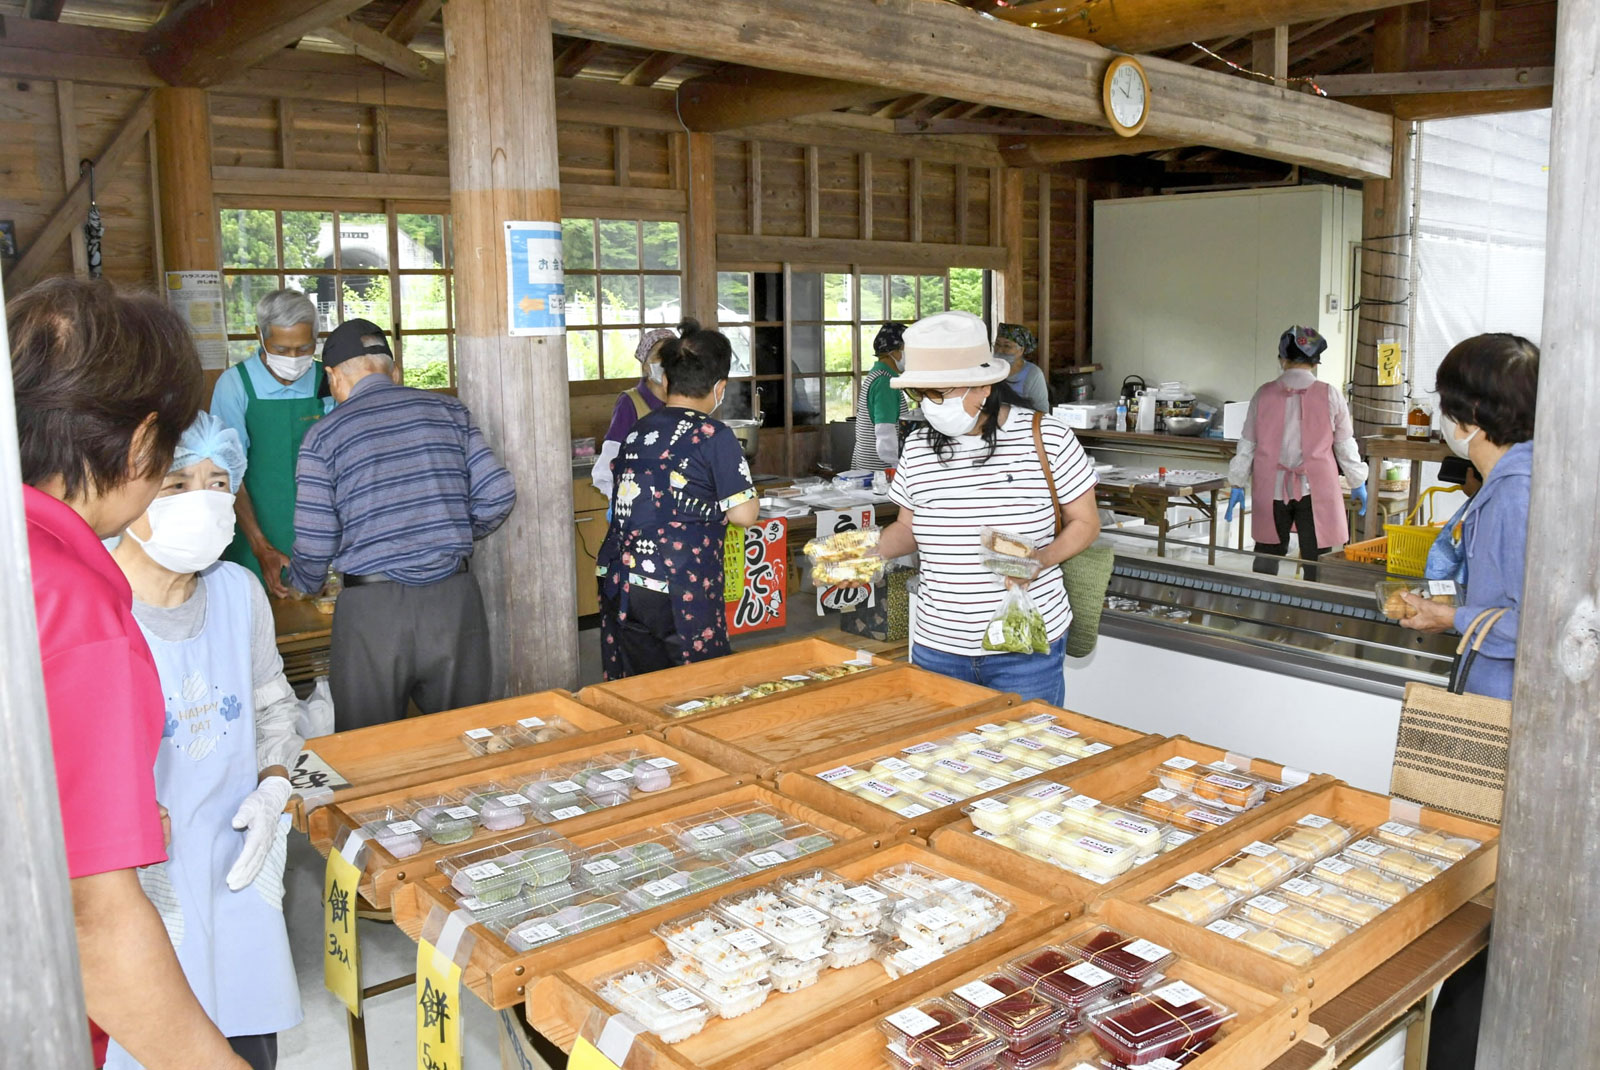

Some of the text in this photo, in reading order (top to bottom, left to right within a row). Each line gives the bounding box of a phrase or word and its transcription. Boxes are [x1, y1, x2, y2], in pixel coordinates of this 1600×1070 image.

[1383, 348, 1394, 377] コーヒー
[178, 702, 218, 720] HAPPY
[191, 720, 210, 733] CAT
[327, 879, 350, 934] 餅
[419, 976, 451, 1043] 餅
